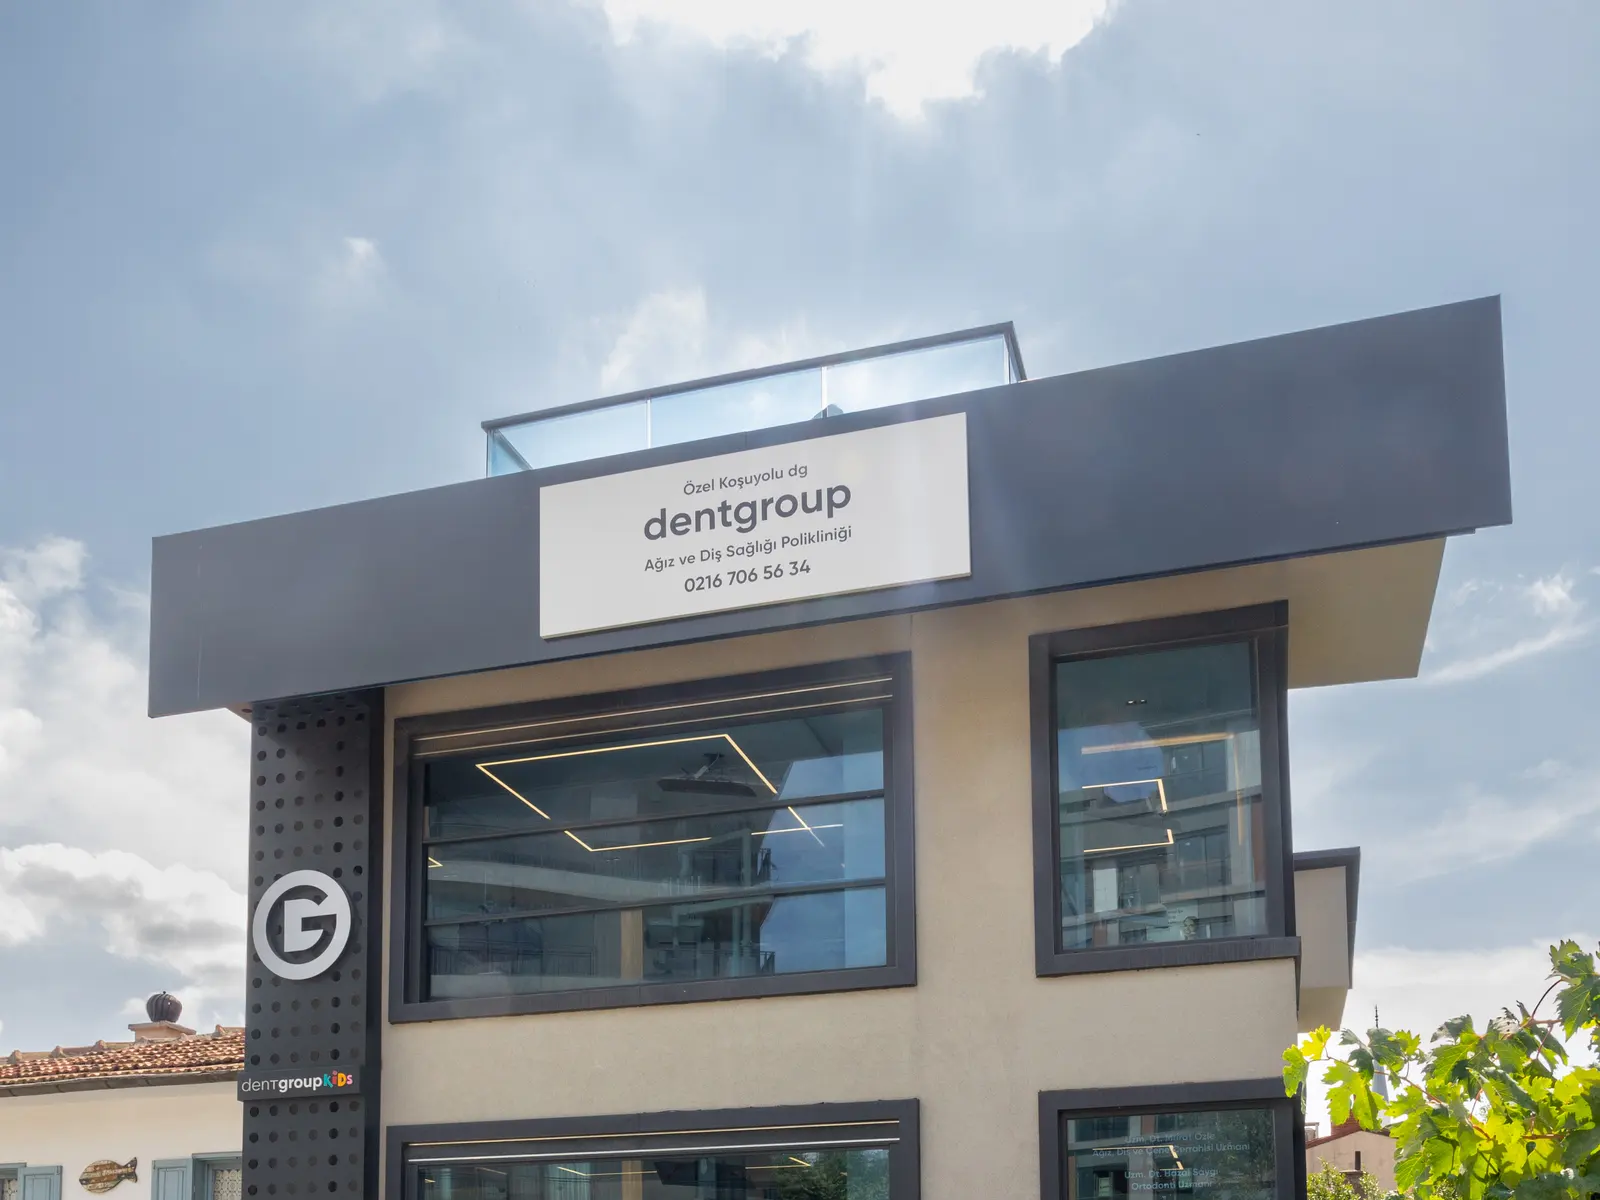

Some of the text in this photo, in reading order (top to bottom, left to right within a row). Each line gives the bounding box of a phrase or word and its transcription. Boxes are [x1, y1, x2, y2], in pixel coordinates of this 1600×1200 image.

[683, 462, 808, 496] Özel Koşuyolu dg
[643, 482, 852, 542] dentgroup
[644, 526, 852, 573] Ağız ve Diş Sağlığı Polikliniği
[684, 559, 811, 593] 0216 706 56 34
